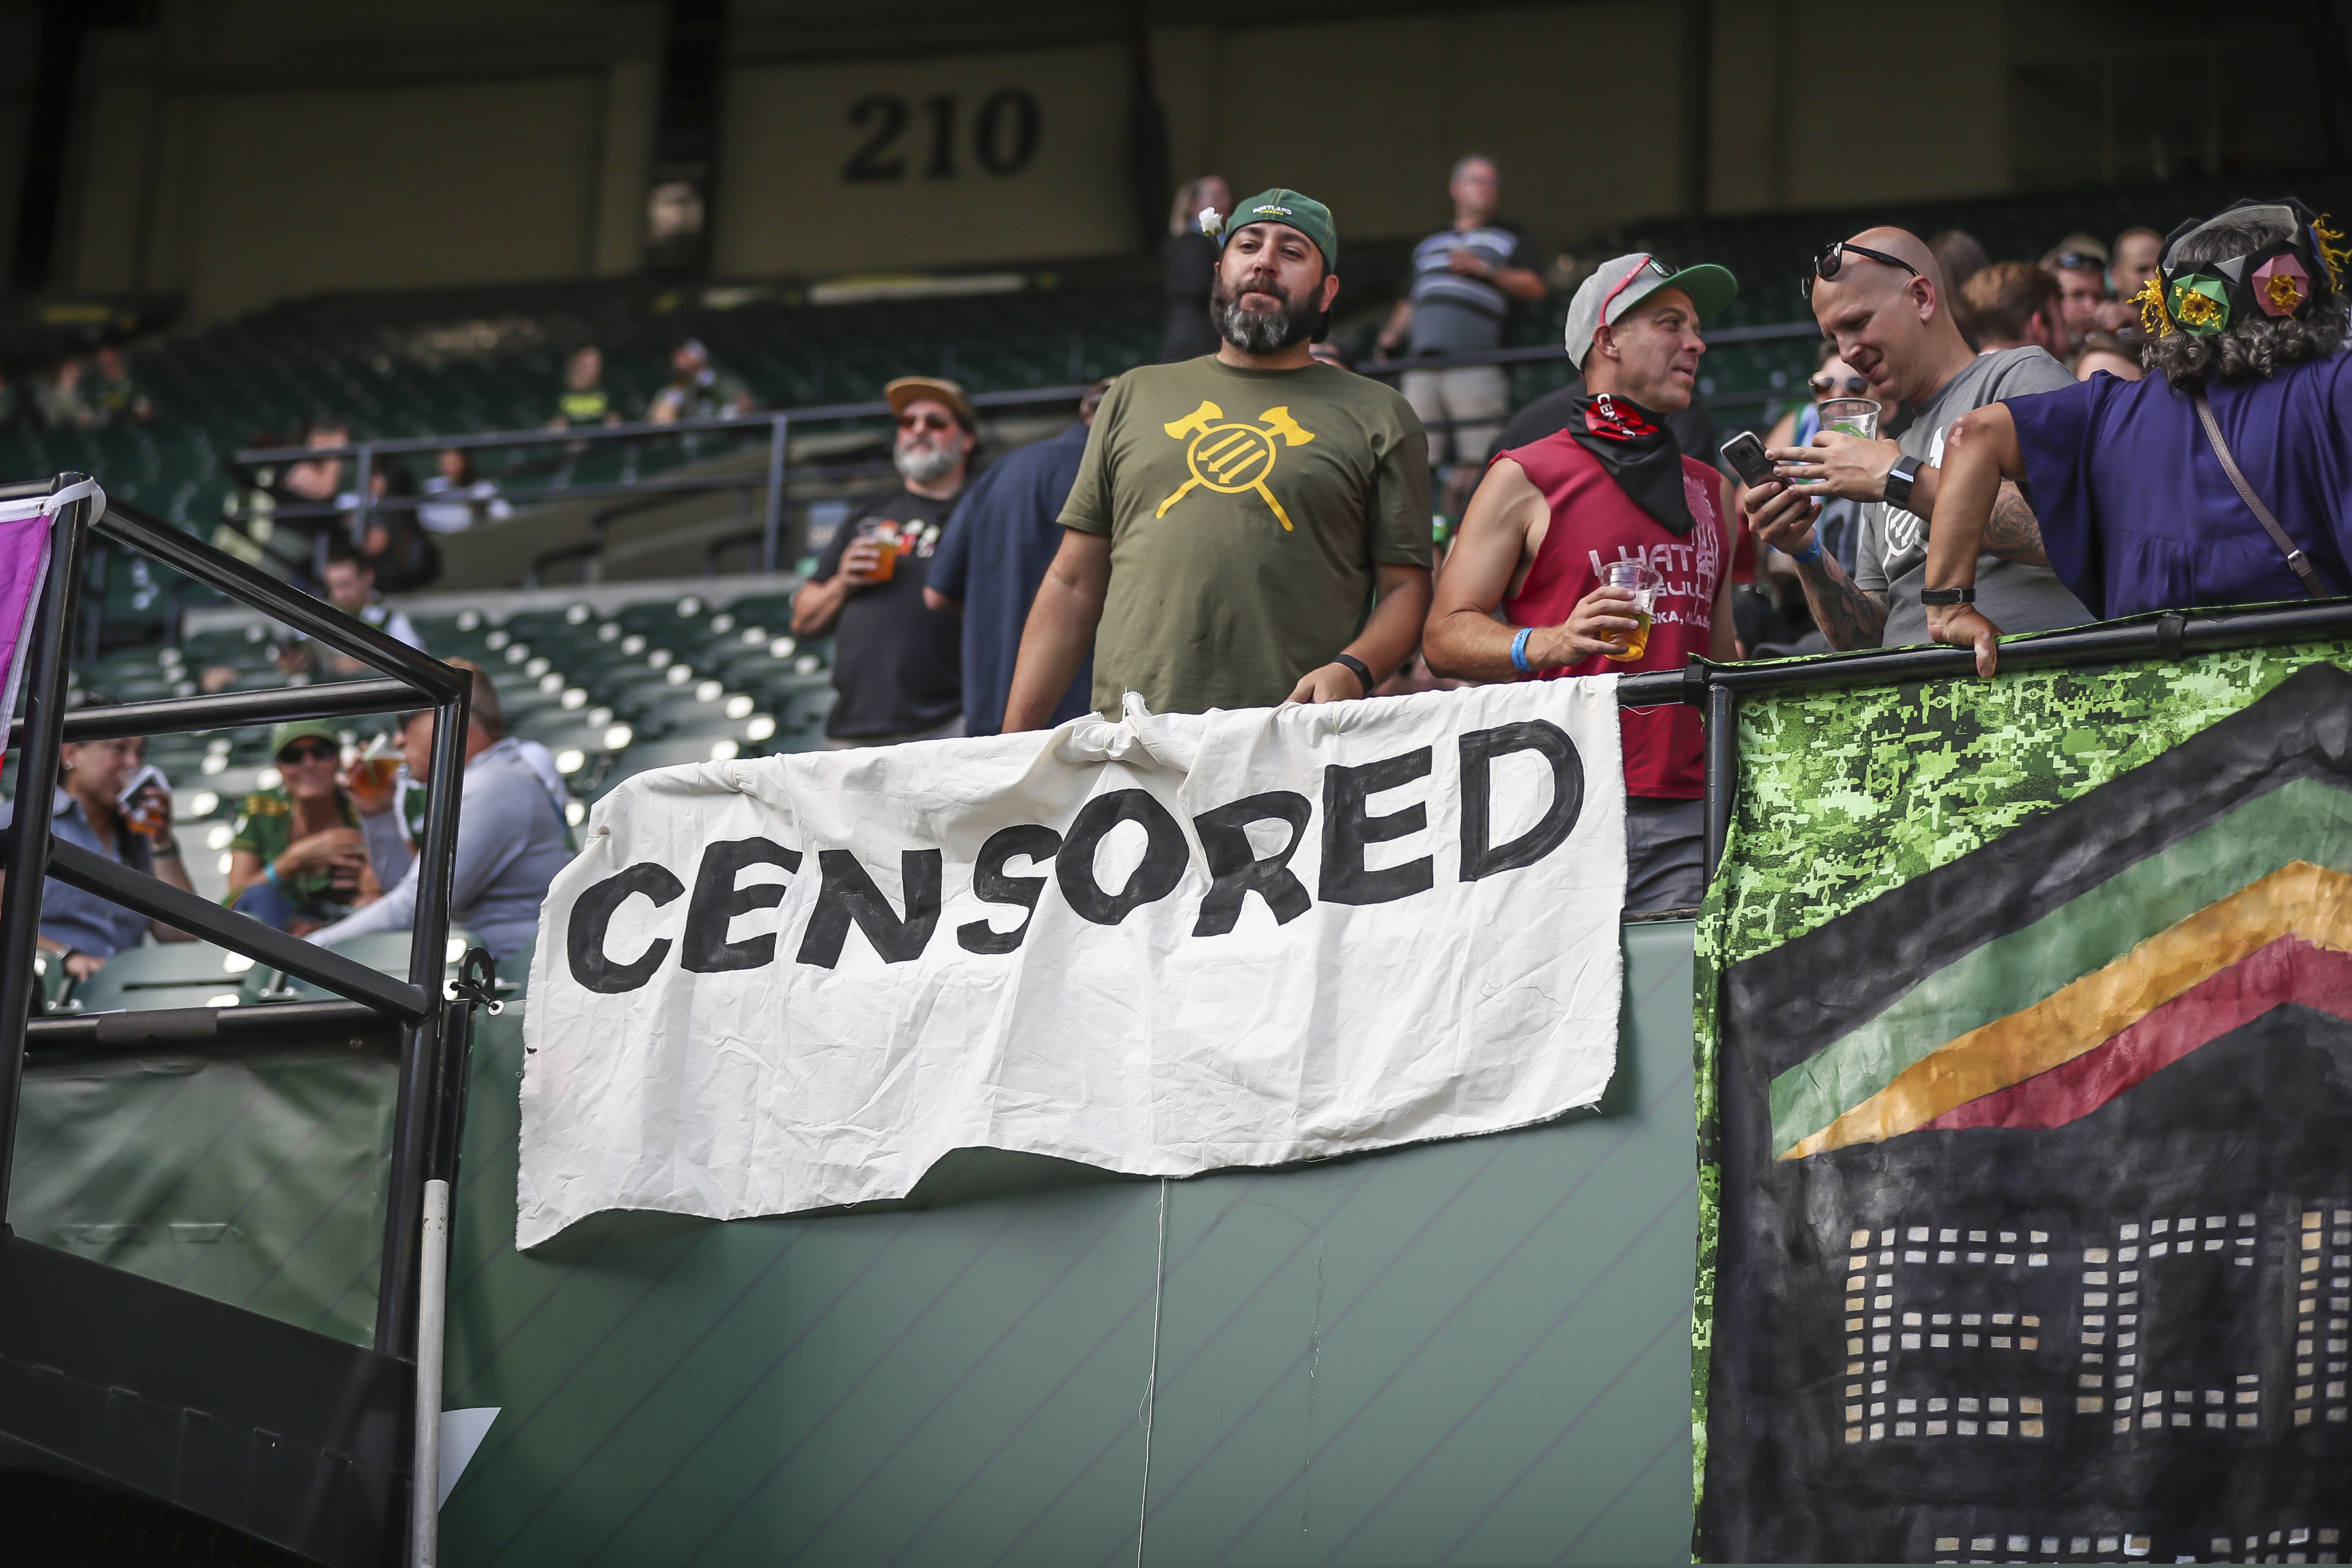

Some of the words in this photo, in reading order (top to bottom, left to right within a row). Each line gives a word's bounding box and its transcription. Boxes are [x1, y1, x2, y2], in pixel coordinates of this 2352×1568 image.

[844, 87, 1040, 182] 210
[1252, 205, 1292, 215] PORTLAND
[567, 719, 1584, 994] CENSORED
